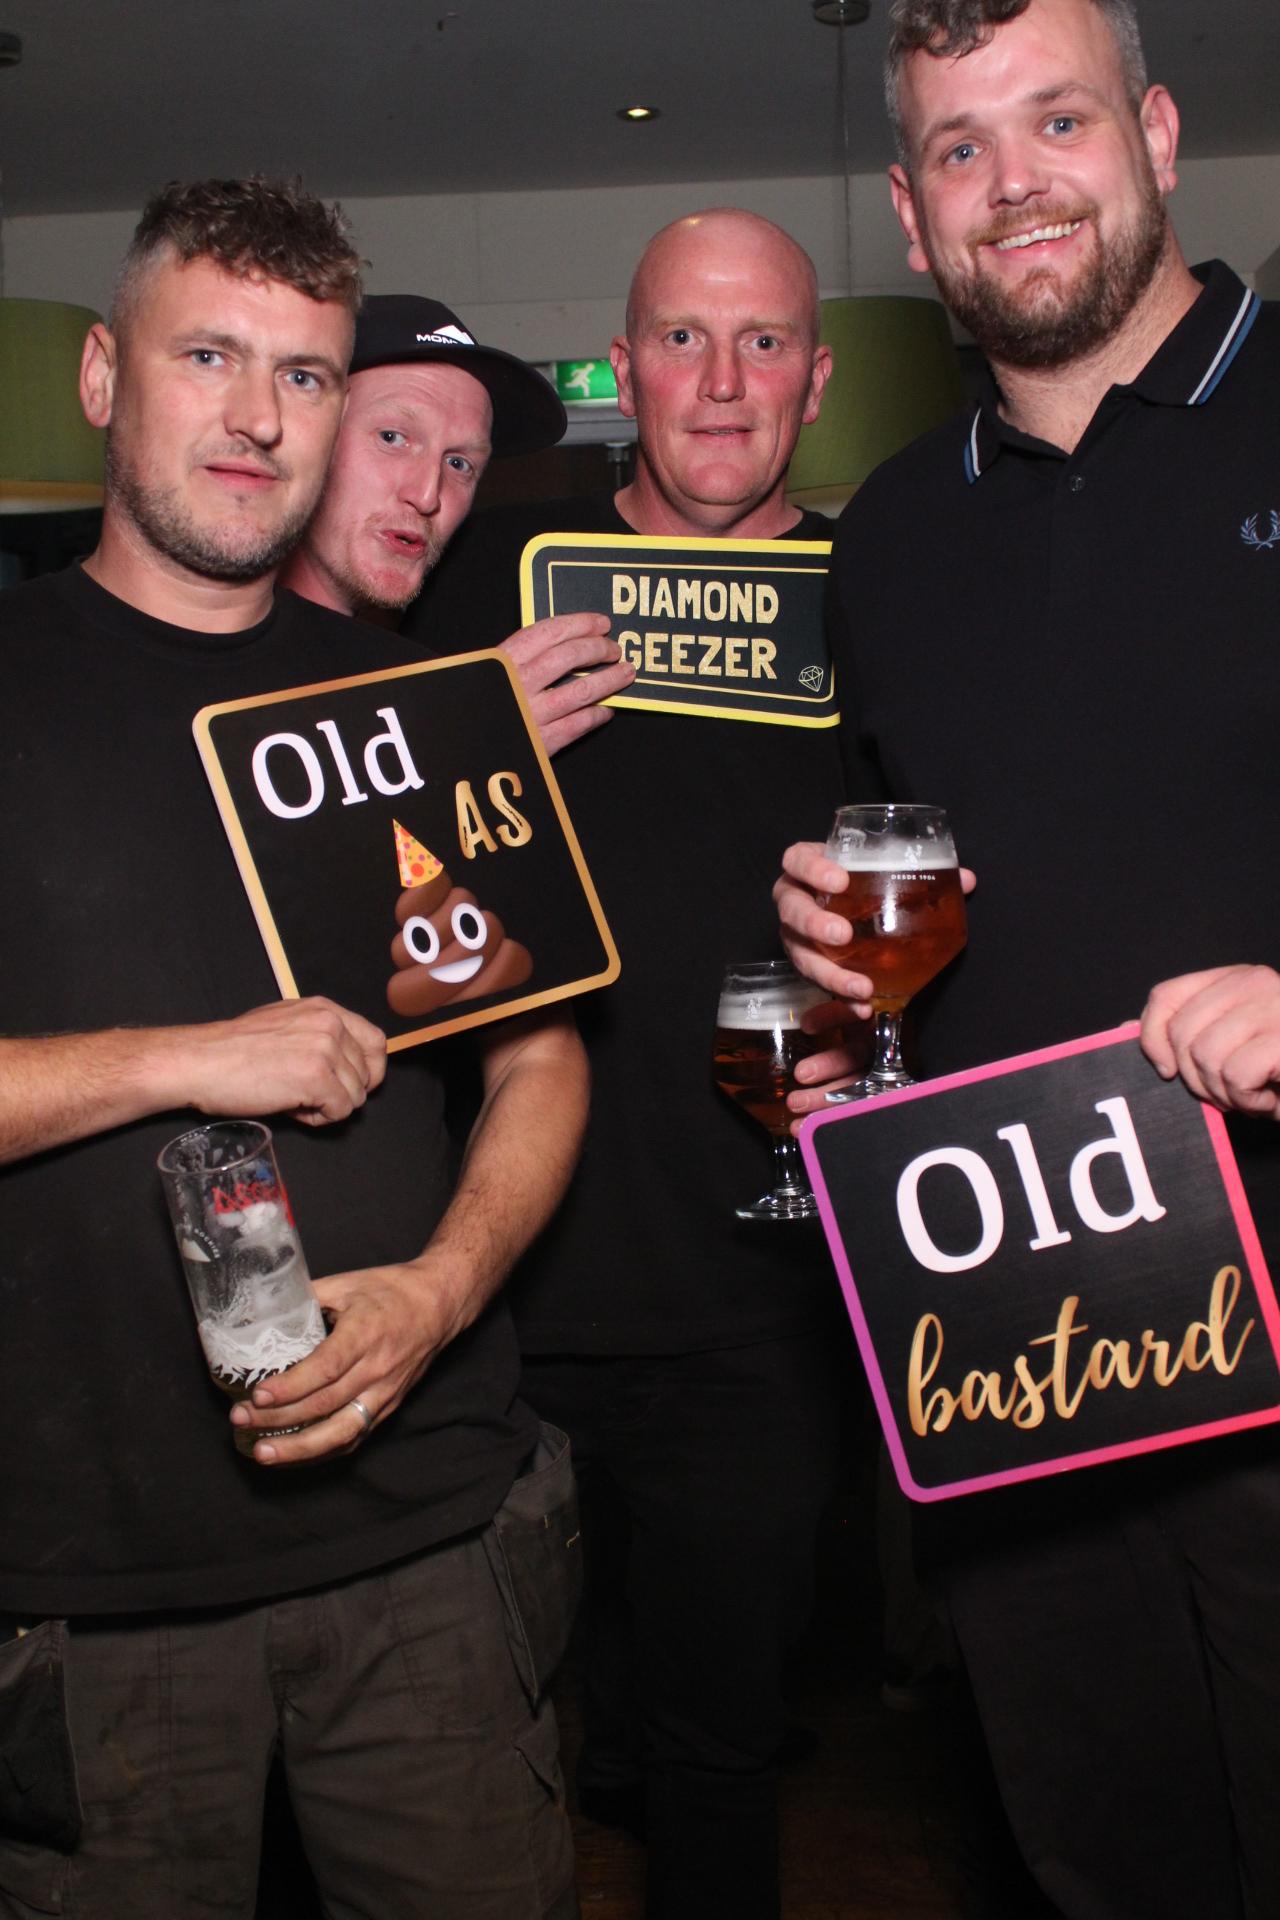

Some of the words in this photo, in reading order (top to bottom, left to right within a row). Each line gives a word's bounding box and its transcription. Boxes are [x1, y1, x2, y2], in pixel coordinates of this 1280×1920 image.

[612, 574, 779, 624] DIAMOND
[617, 630, 777, 680] GEEZER
[252, 707, 425, 819] Old
[455, 771, 533, 859] AS
[896, 1096, 1167, 1273] Old
[908, 1265, 1255, 1436] bastard
